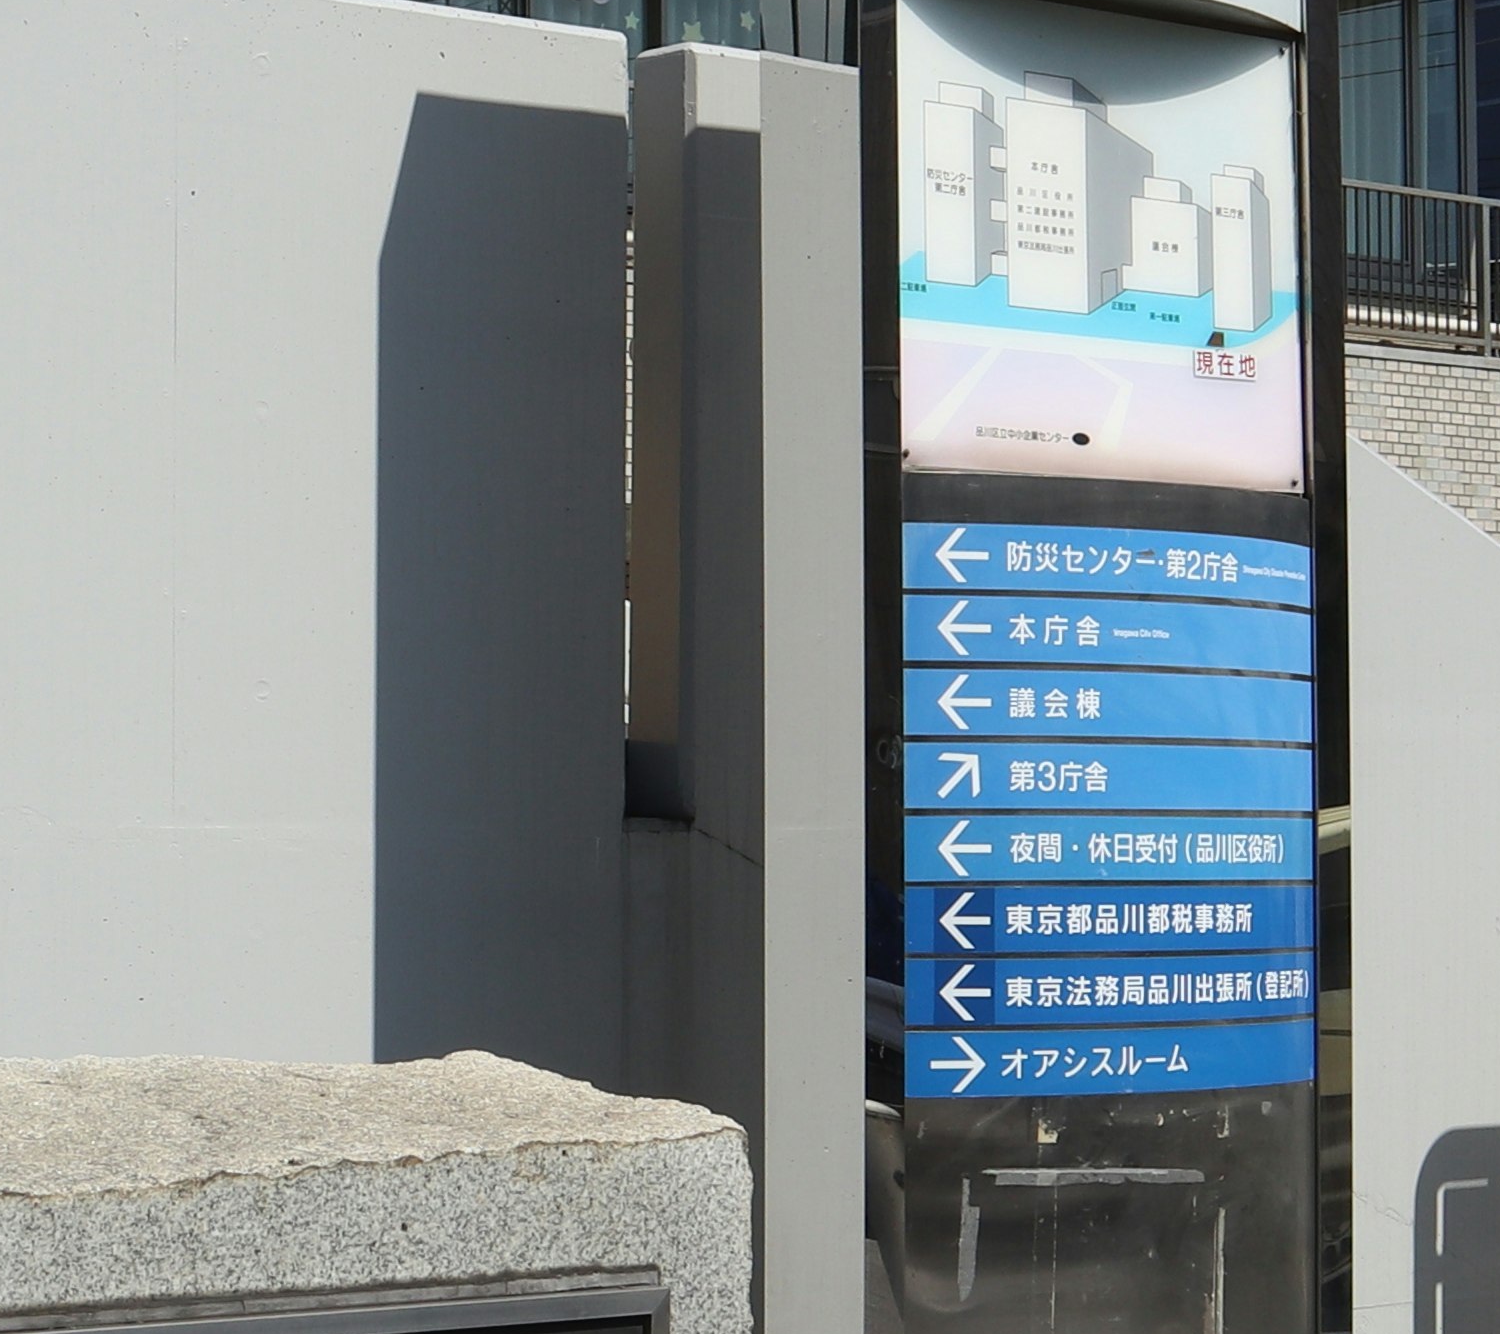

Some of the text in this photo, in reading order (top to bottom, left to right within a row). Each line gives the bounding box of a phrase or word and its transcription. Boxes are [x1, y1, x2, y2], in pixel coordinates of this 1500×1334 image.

[927, 168, 974, 183] 防災センター
[1196, 351, 1256, 378] 現在地
[1006, 540, 1239, 584] 防災センター・第2庁舎
[1009, 613, 1100, 647] 本庁舎
[1009, 687, 1101, 720] 議会棟
[1009, 761, 1109, 793] 第3庁舎
[1006, 902, 1253, 936] 東京都品川都税事務所
[1001, 1044, 1189, 1079] オアシスルーム
